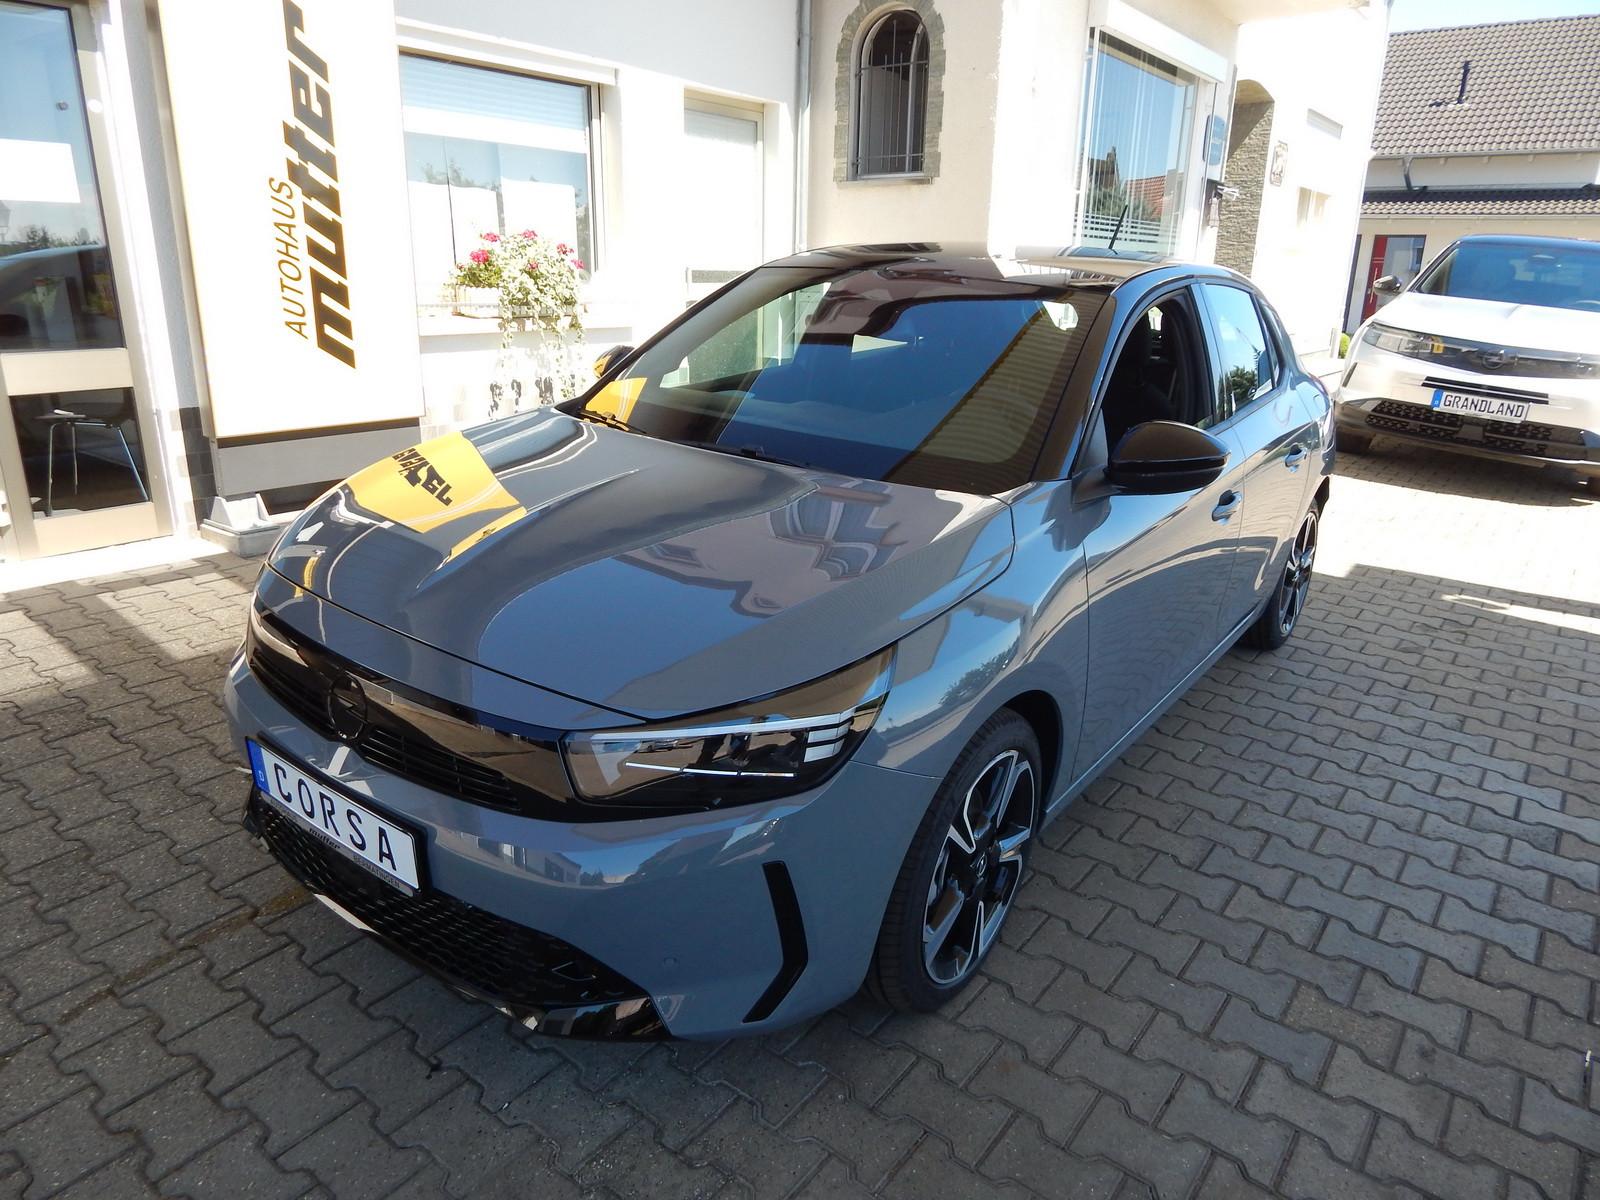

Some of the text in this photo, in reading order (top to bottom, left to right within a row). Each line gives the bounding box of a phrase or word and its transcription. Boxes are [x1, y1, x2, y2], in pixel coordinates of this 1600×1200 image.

[282, 0, 356, 369] mutter
[268, 177, 309, 340] AUTOHAUS
[1443, 394, 1525, 418] GRANDLAND
[273, 762, 397, 872] CORSA
